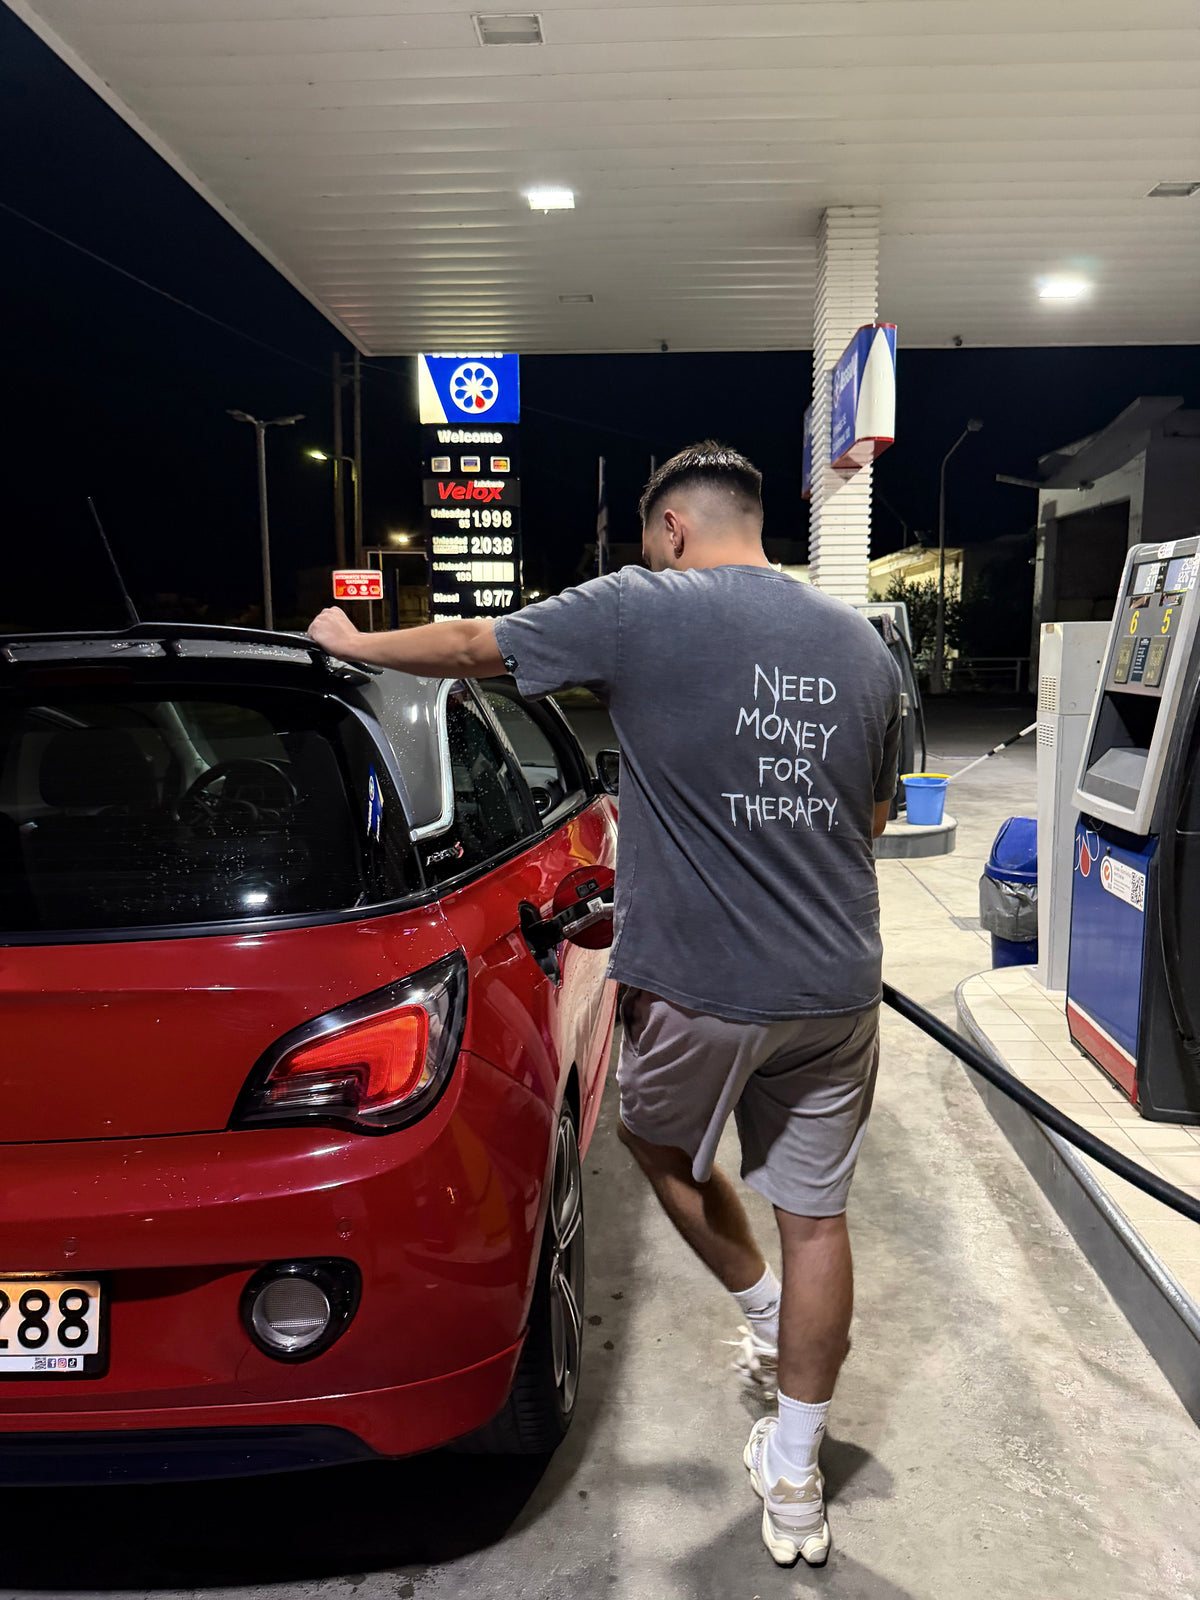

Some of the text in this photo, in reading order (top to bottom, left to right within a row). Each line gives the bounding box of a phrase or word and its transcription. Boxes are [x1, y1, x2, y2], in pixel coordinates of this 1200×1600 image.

[437, 429, 503, 444] Welcome
[437, 481, 504, 503] Velox
[472, 509, 513, 528] 1.998
[433, 588, 514, 608] Diesel 1.977
[1129, 608, 1173, 635] 6 5
[754, 663, 836, 712] NEED
[735, 707, 837, 761] MONEY
[758, 757, 813, 795] FOR
[721, 792, 839, 831] THERAPY.
